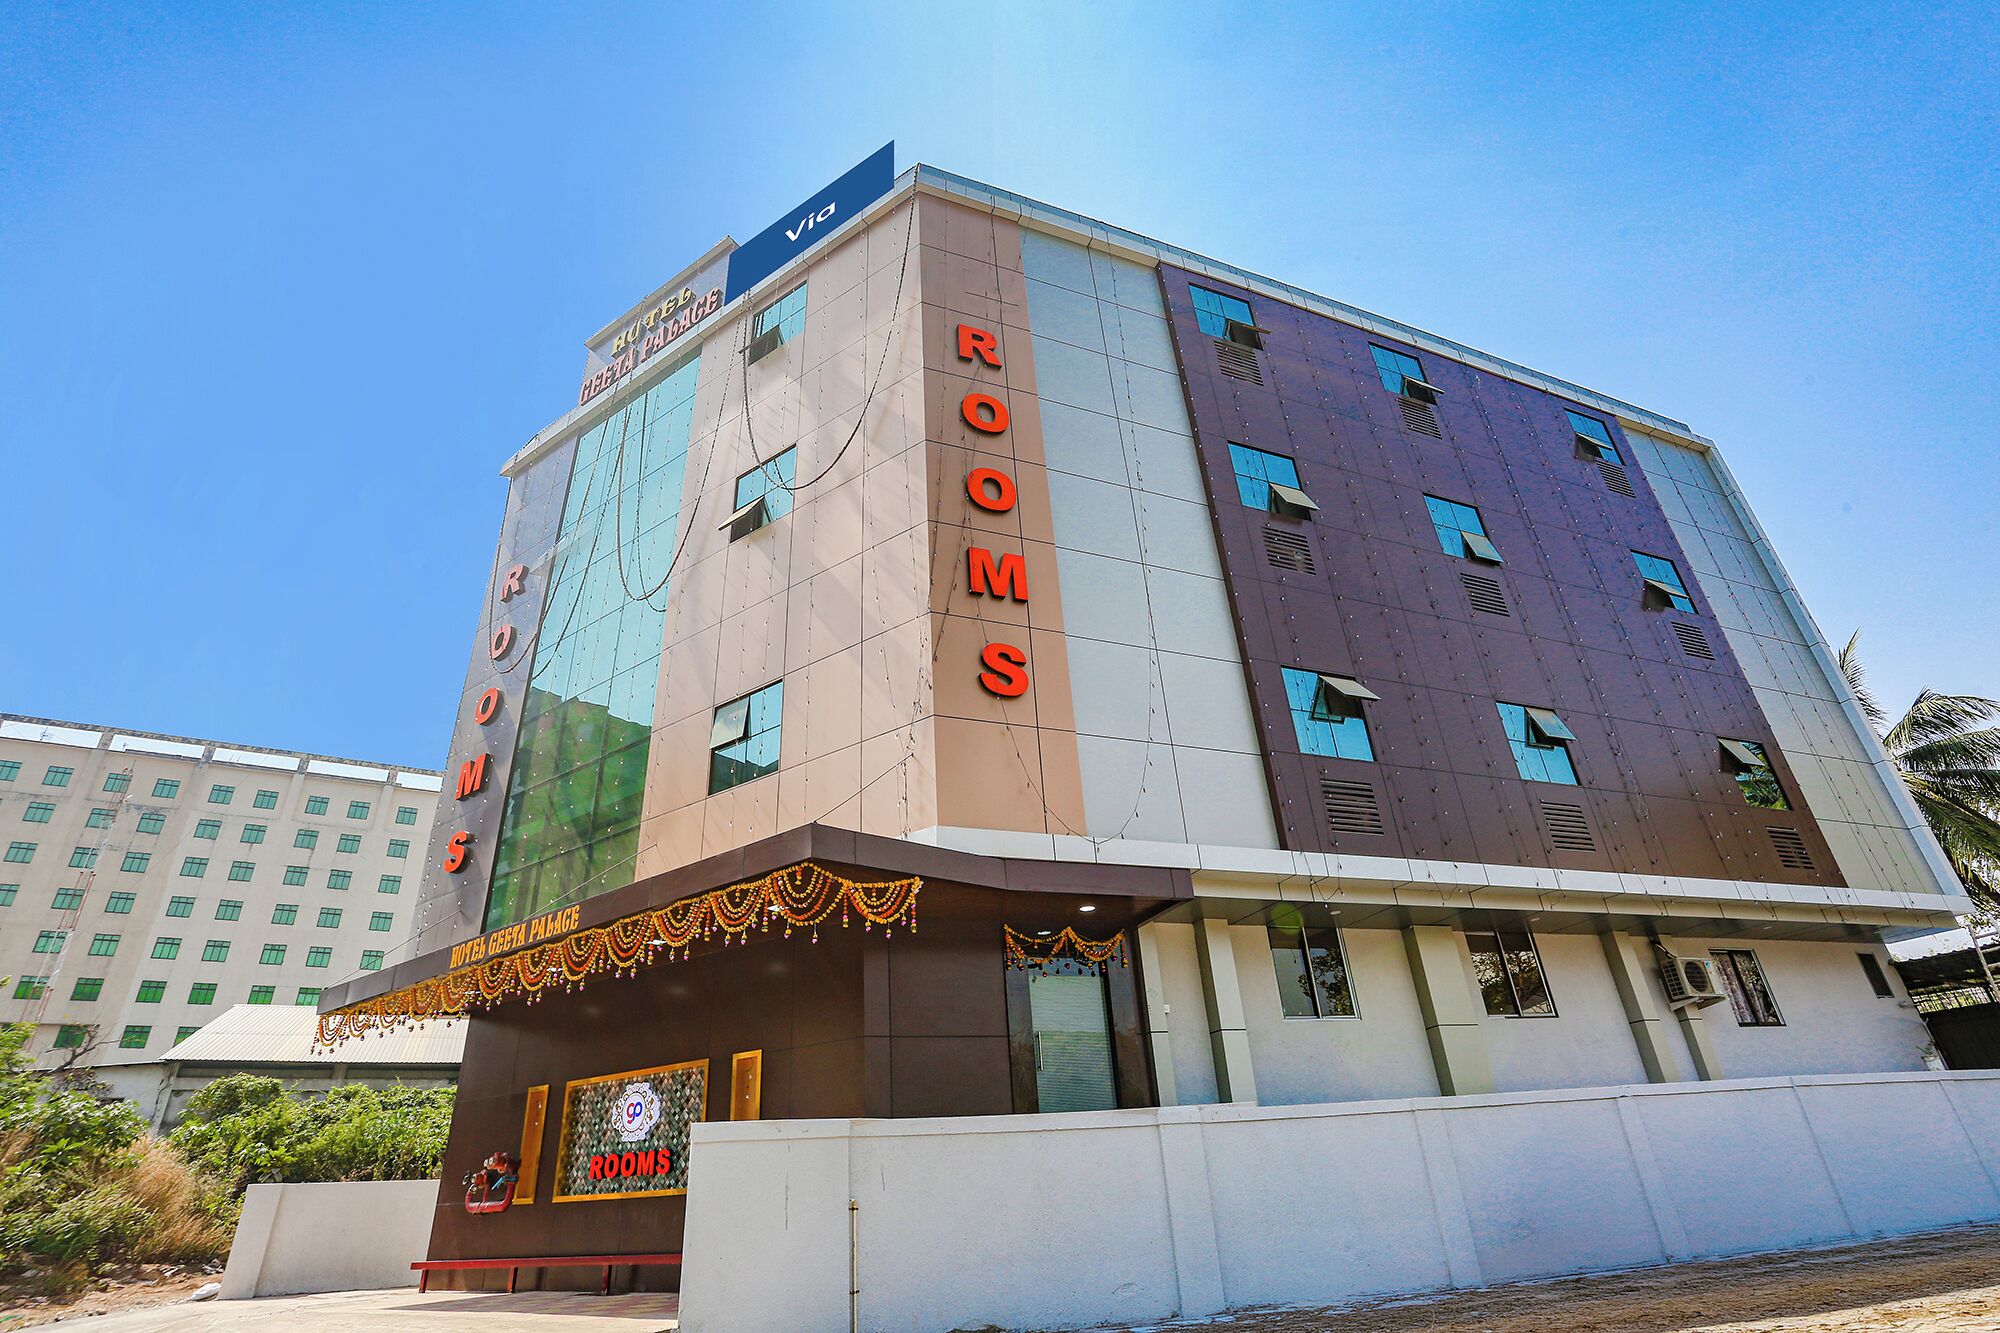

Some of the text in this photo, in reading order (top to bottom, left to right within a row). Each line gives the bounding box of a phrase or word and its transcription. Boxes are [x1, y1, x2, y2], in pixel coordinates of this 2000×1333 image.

[785, 201, 836, 242] Via
[580, 287, 722, 406] GEETA PALACE
[611, 287, 693, 357] HOTEL
[956, 323, 1029, 699] ROOMS
[443, 563, 528, 874] ROOMS
[450, 905, 581, 969] HOTEL GEETA PALACE
[589, 1149, 671, 1180] ROOMS
